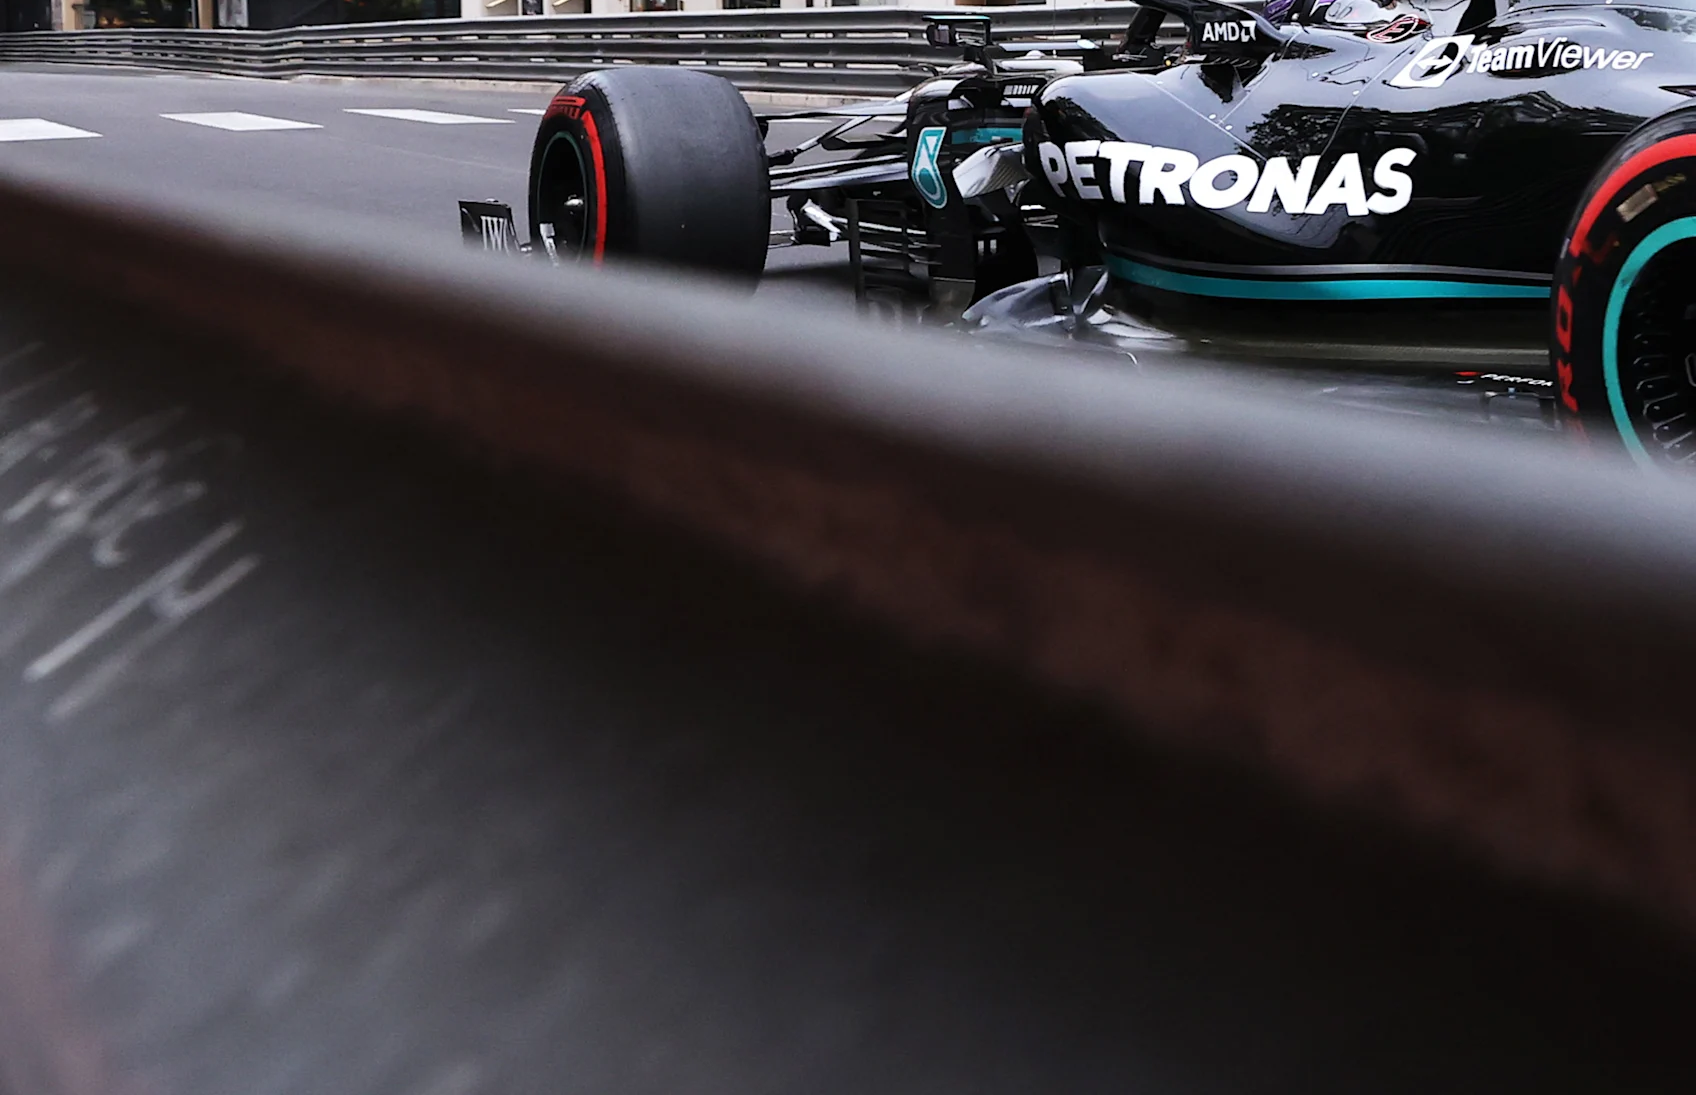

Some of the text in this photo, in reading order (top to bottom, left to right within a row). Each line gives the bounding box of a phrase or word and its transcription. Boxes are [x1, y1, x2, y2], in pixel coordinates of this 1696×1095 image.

[1203, 21, 1239, 42] AMD
[1466, 37, 1653, 75] TeamViewer
[1038, 139, 1417, 217] PETRONAS
